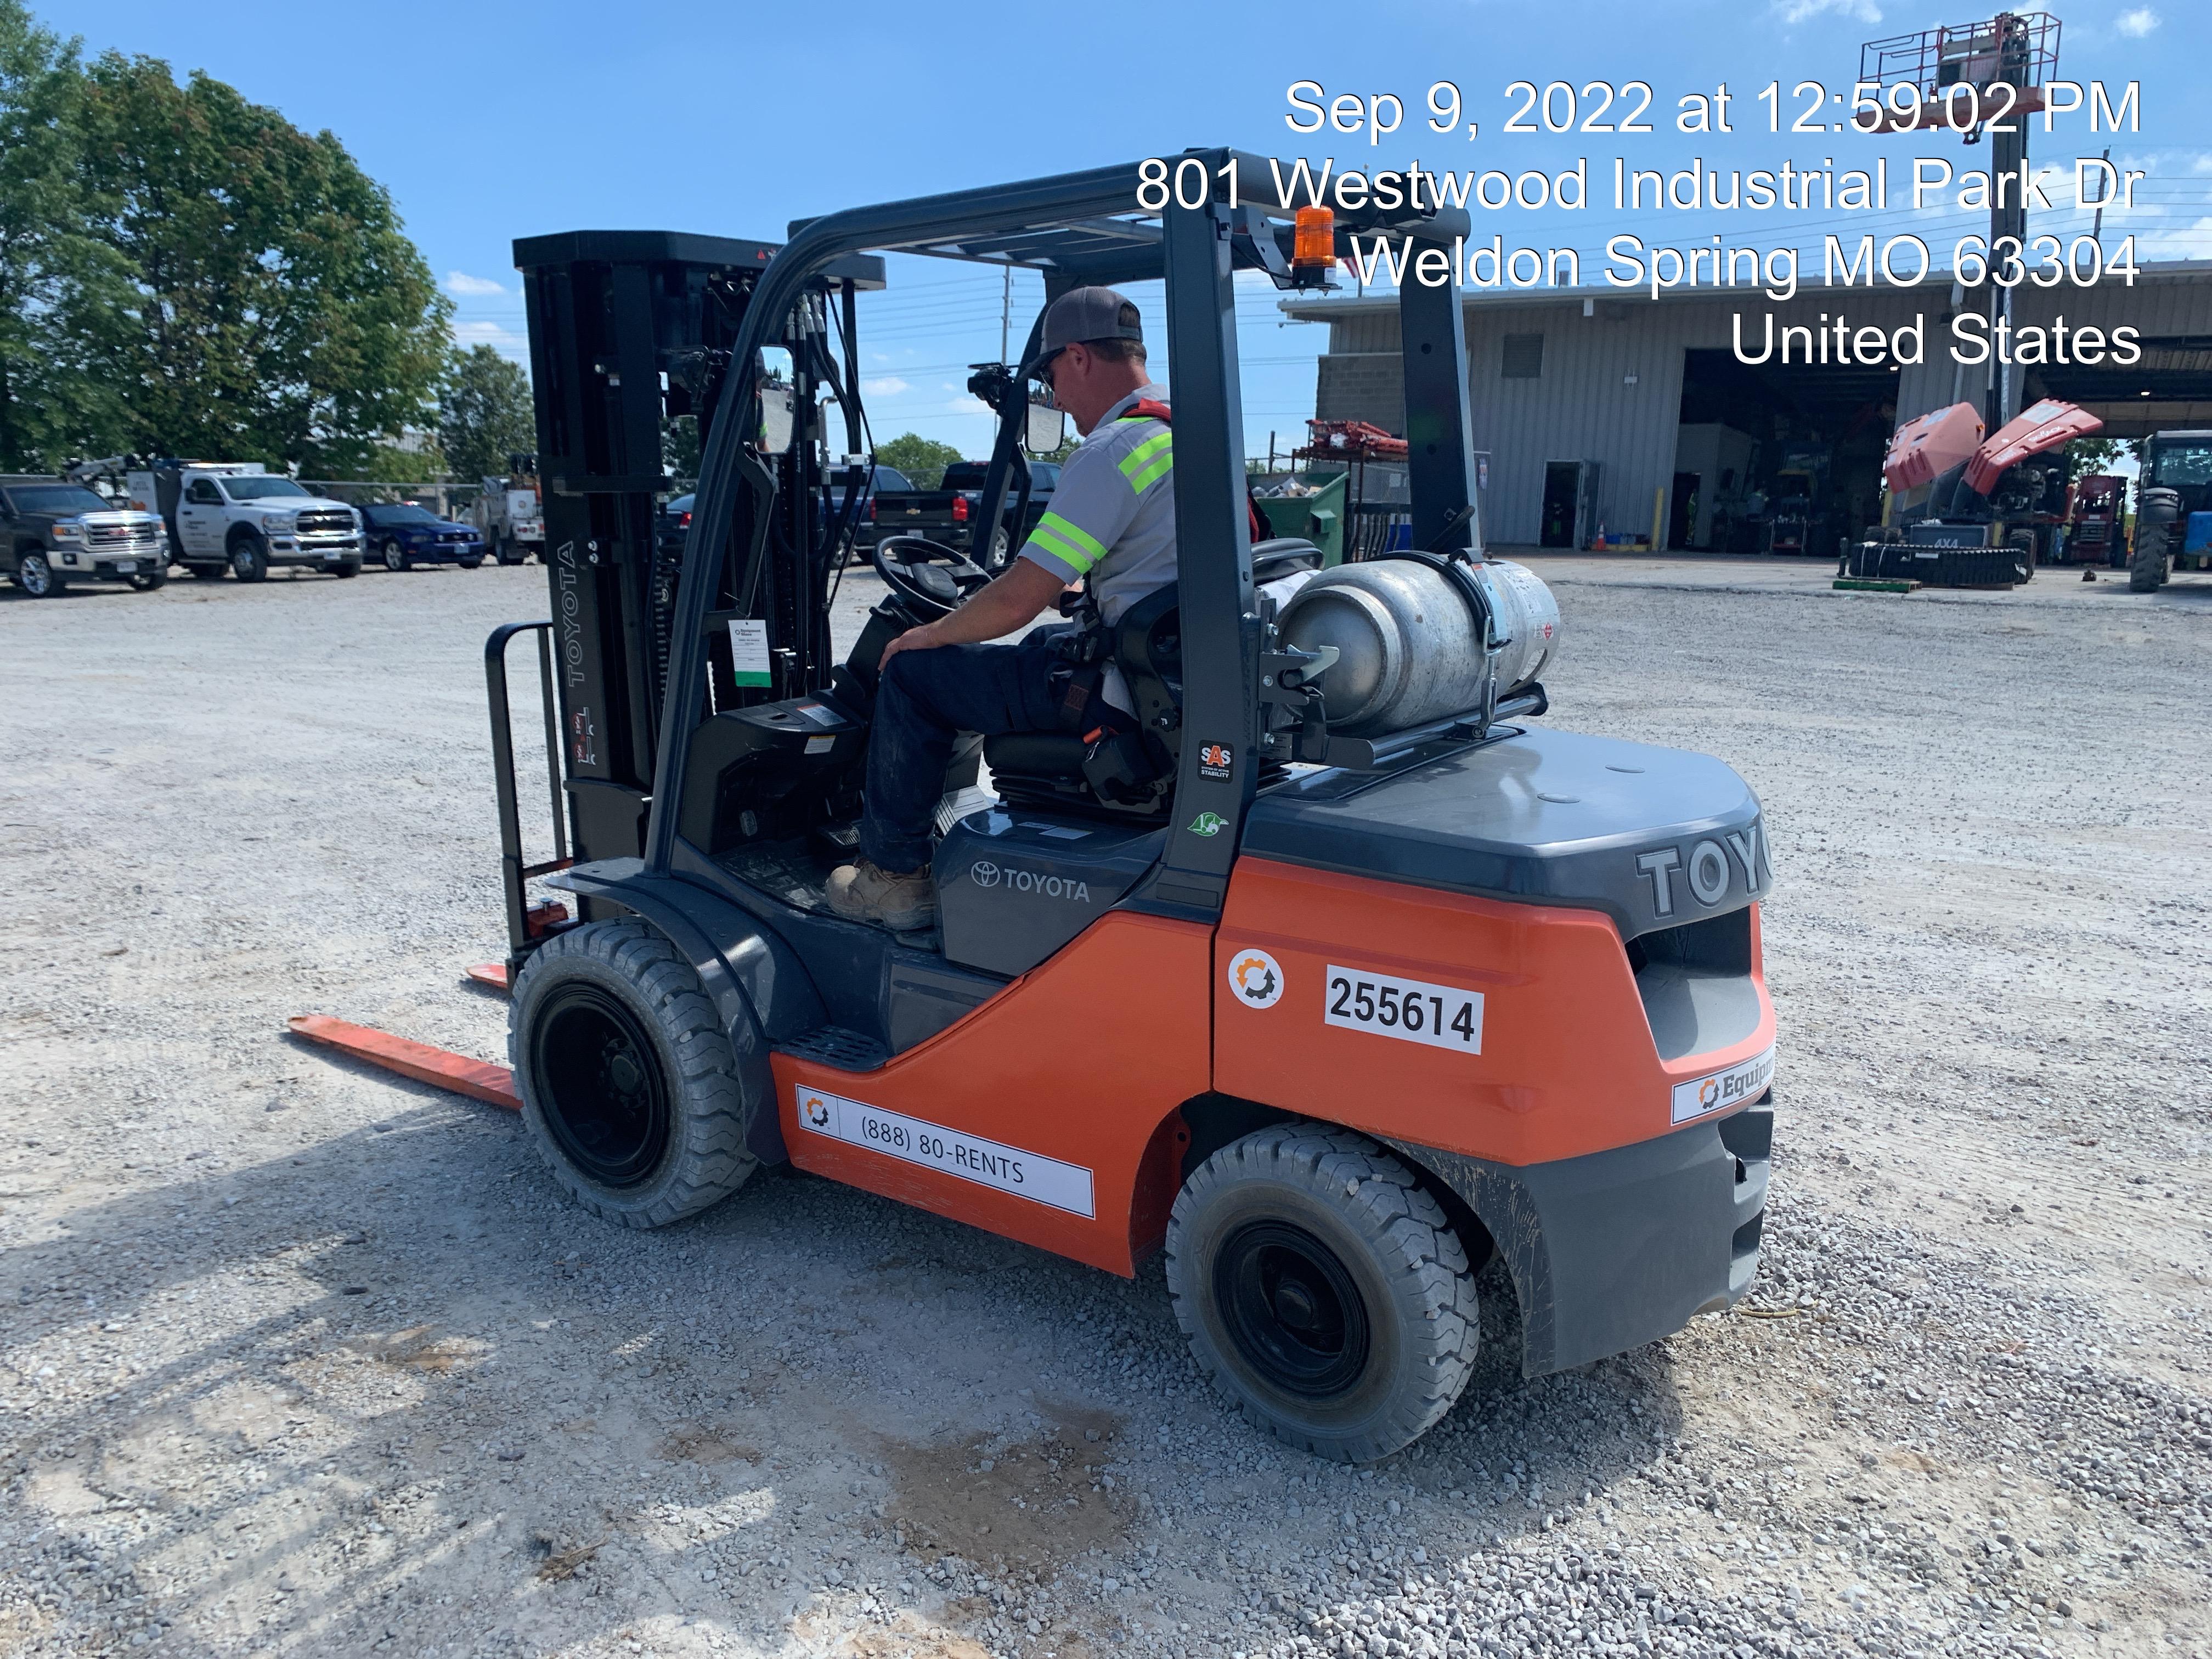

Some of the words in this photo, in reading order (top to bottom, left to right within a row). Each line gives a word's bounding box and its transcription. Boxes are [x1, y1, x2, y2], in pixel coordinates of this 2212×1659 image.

[557, 540, 585, 687] TOYOTA
[1201, 745, 1231, 767] SAS
[1201, 769, 1229, 778] STABILITY
[1004, 868, 1090, 903] TOYOTA
[1330, 977, 1475, 1042] 255614
[861, 1115, 911, 1152] (888)
[919, 1134, 1025, 1184] 80-RENTS
